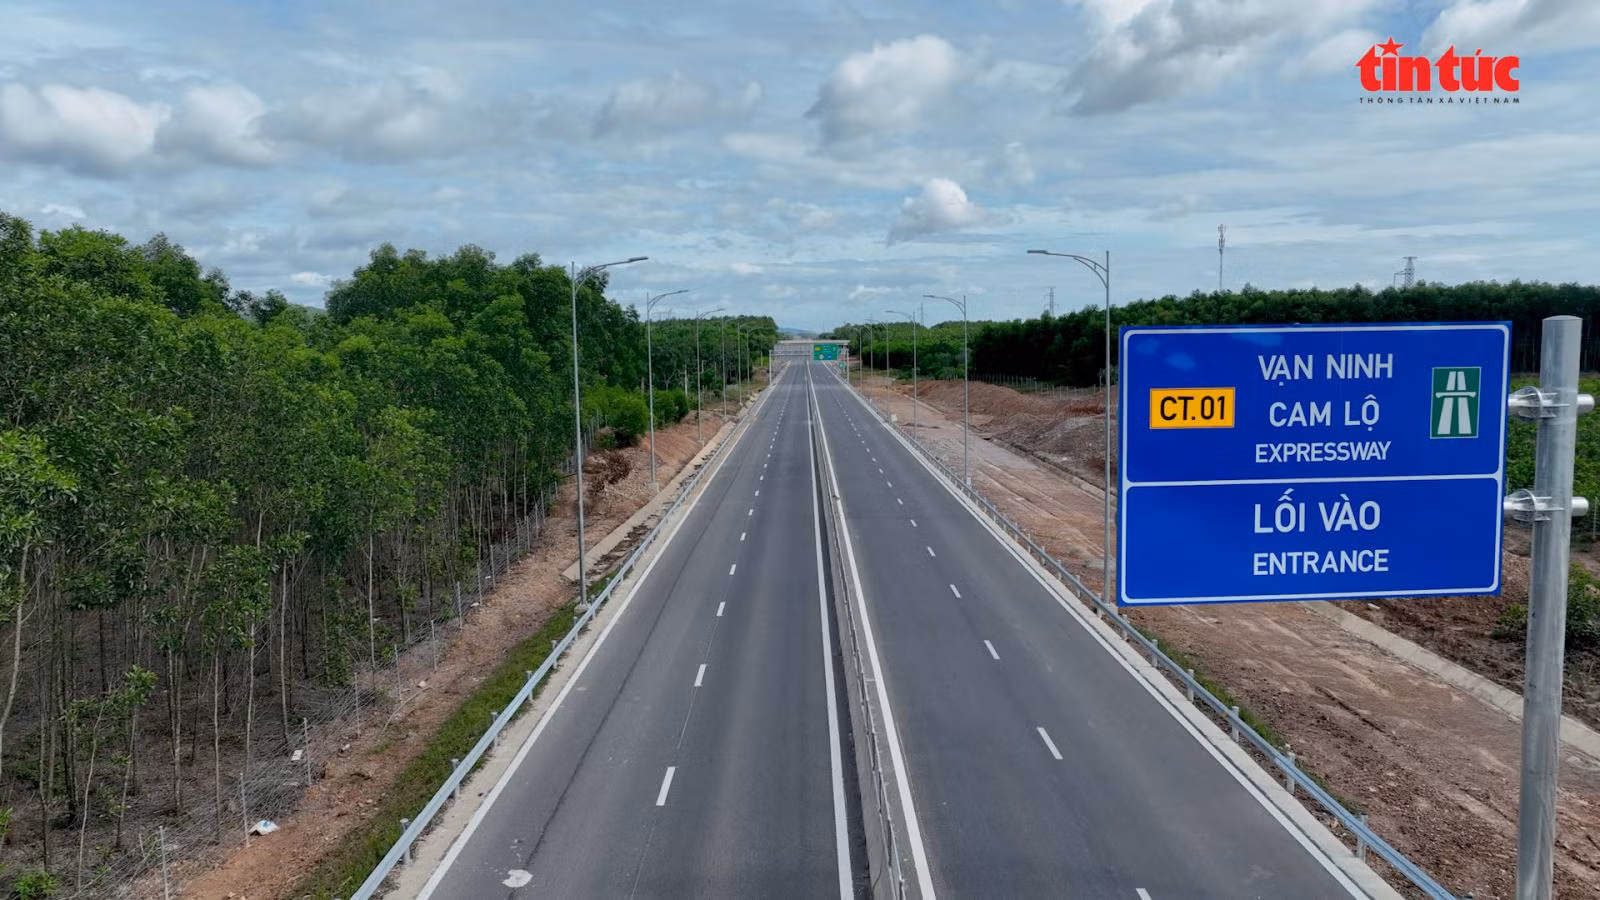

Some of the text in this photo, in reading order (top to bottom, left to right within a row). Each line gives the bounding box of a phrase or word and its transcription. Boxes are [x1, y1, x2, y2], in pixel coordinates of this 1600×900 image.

[1258, 353, 1393, 386] VẠN NINH
[1160, 395, 1225, 421] CT.01
[1269, 394, 1380, 431] CAM LỘ
[1255, 441, 1391, 463] EXPRESSWAY
[1254, 488, 1381, 534] LỐI VÀO
[1253, 549, 1389, 576] ENTRANCE
